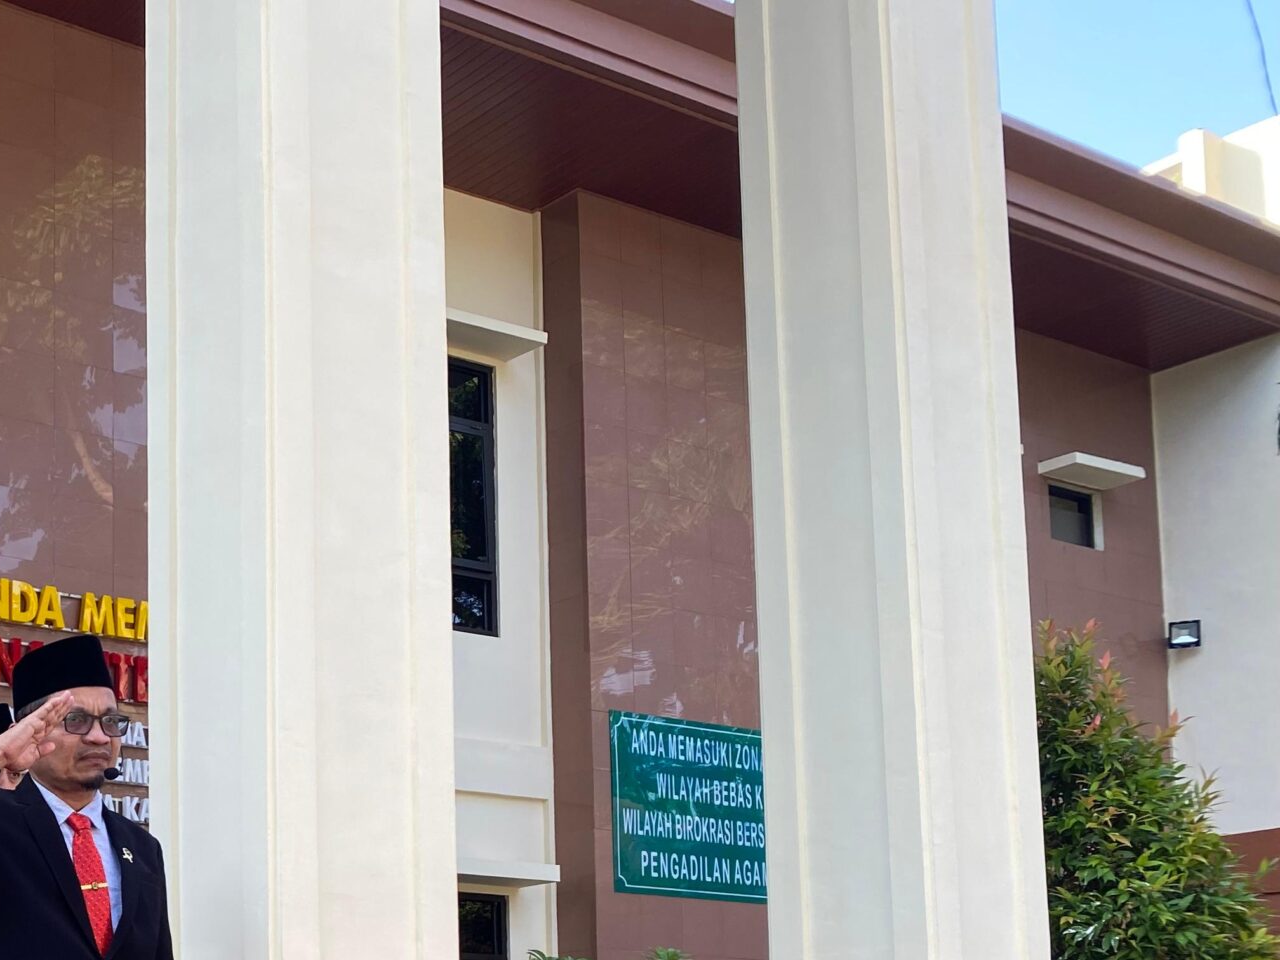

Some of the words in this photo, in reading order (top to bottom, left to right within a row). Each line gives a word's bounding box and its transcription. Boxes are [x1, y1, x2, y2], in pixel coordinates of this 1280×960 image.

[631, 727, 666, 758] ANDA
[668, 733, 733, 768] MEMASUKI
[656, 772, 710, 805] WILAYAH
[714, 780, 753, 810] BEBAS
[622, 807, 672, 838] WILAYAH
[675, 814, 734, 846] BIROKRASI
[737, 822, 765, 849] BERS
[641, 850, 731, 885] PENGADILAN
